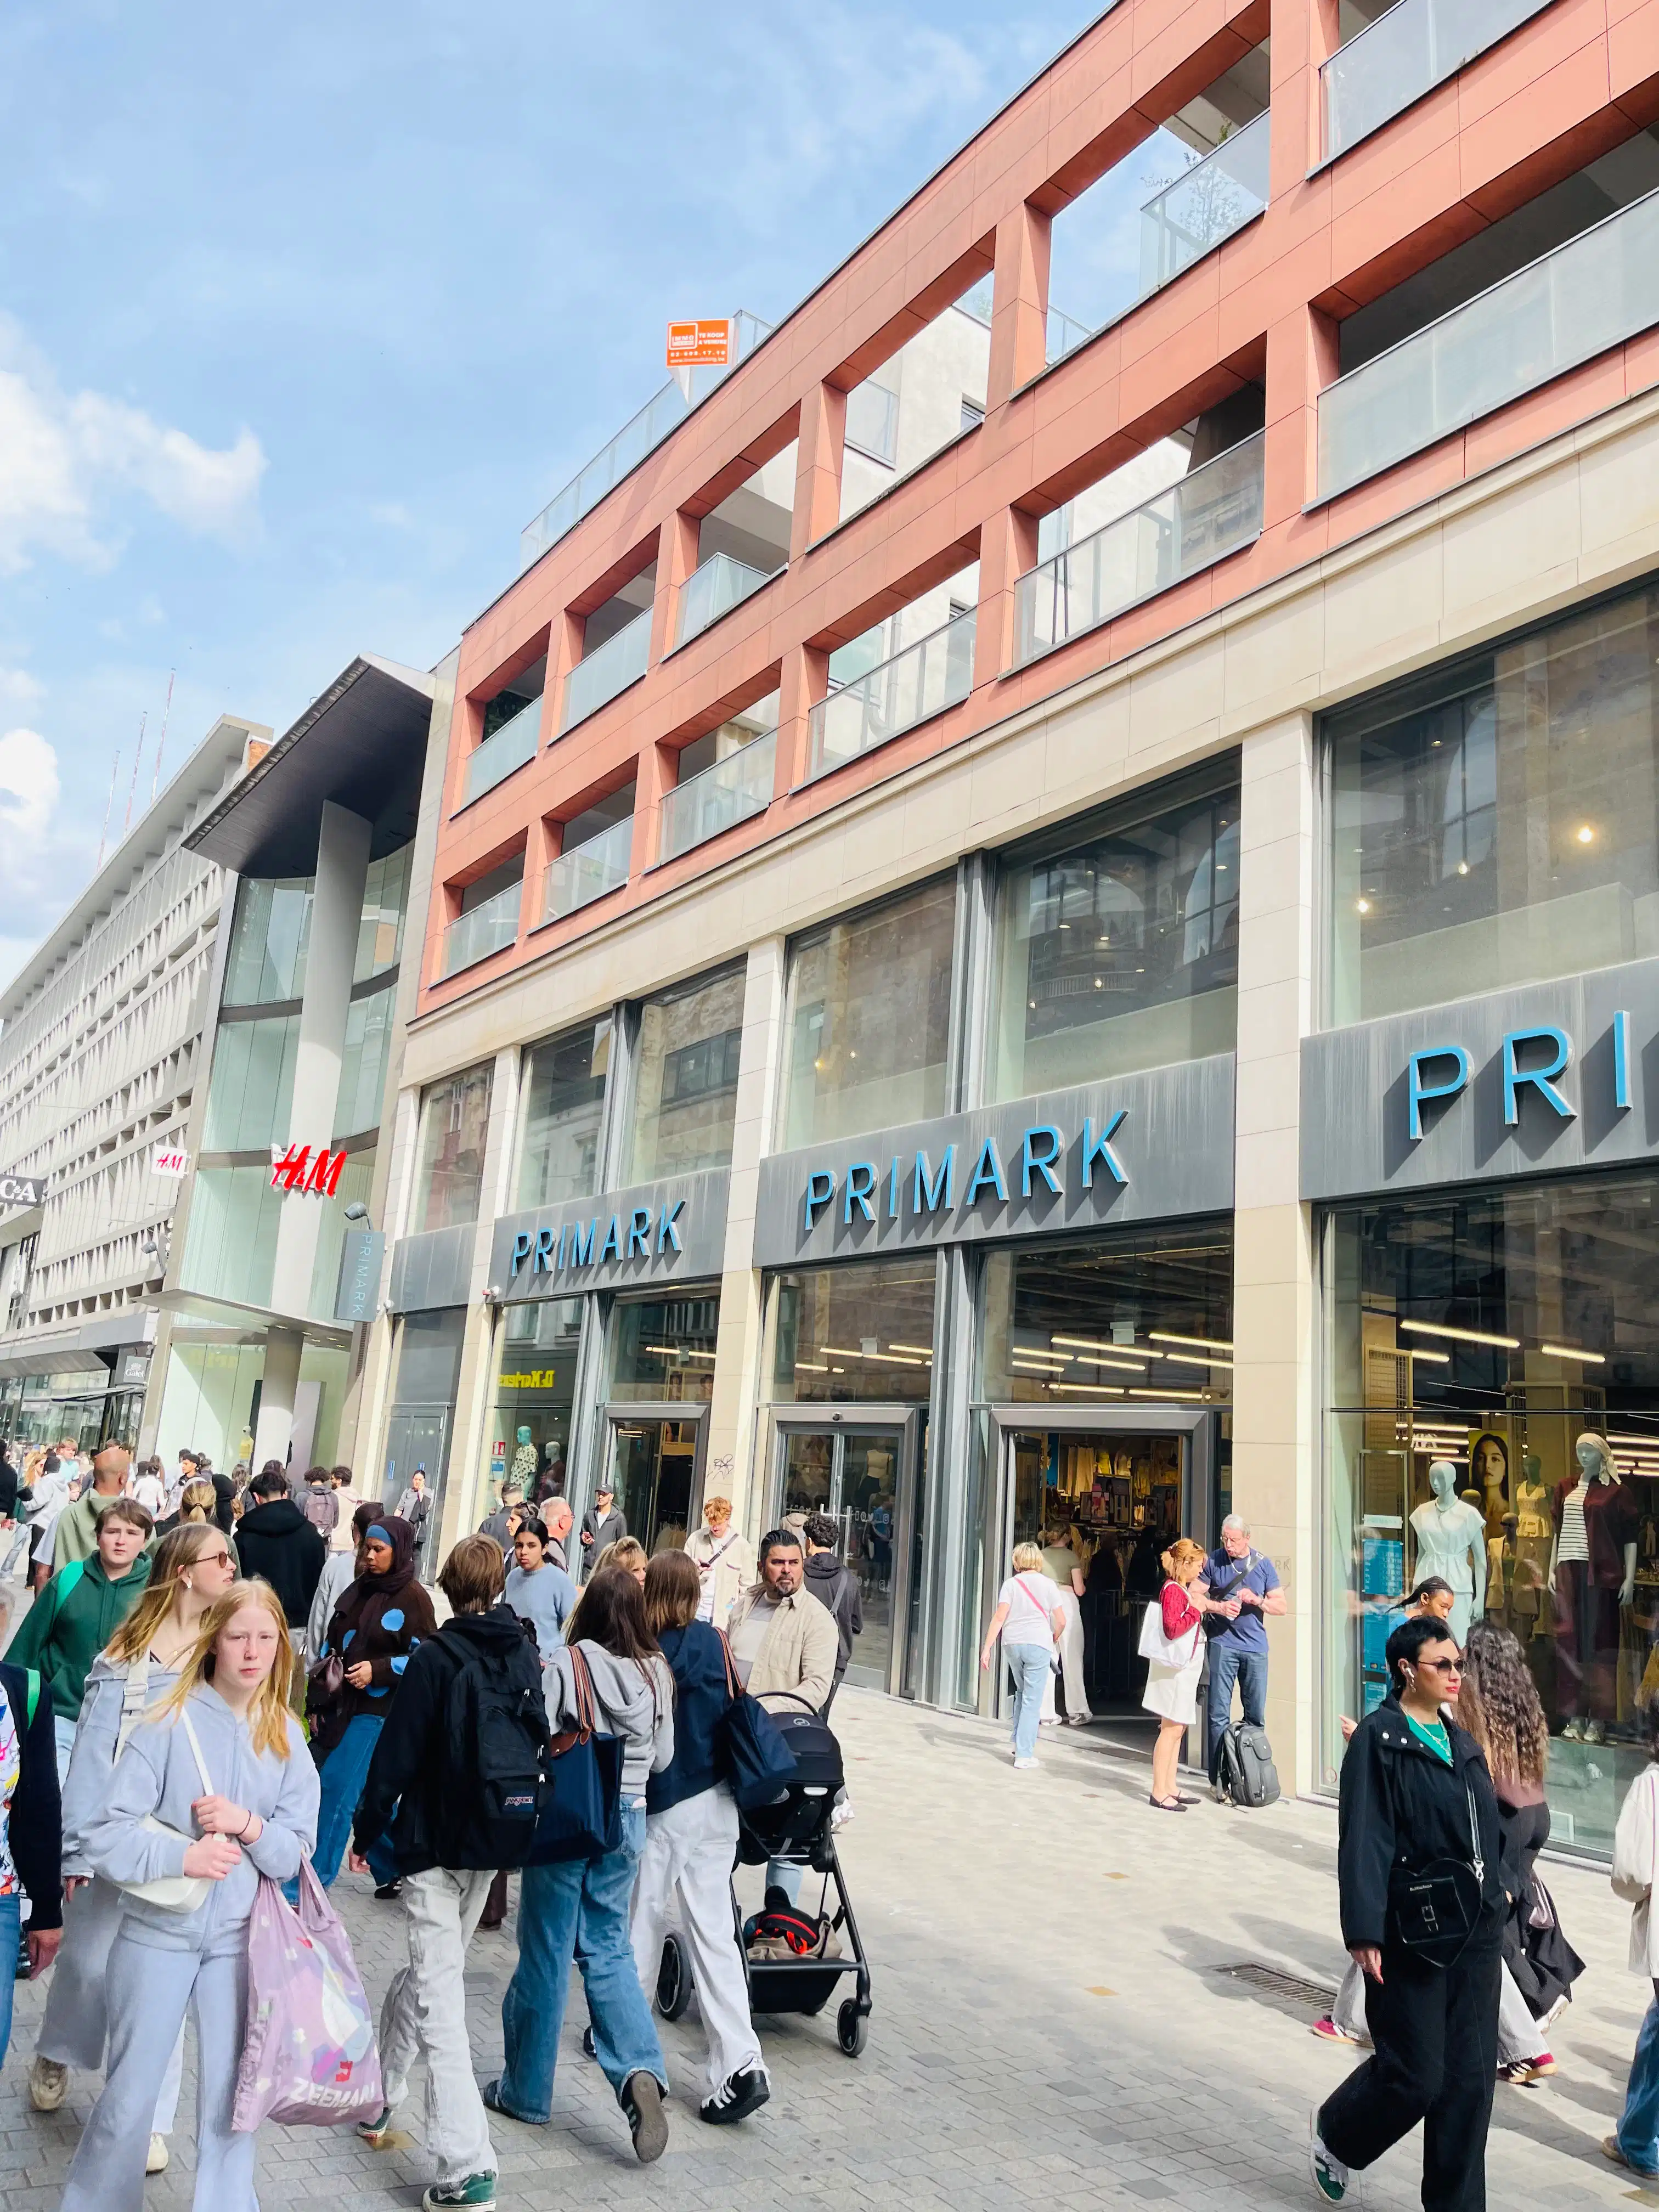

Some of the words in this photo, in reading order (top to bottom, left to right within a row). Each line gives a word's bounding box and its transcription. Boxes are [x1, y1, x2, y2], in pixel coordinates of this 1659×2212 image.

[156, 1153, 184, 1171] H&M
[270, 1143, 348, 1198] H&M
[804, 1110, 1130, 1231] PRIMARK
[0, 1179, 37, 1203] C&A
[511, 1199, 686, 1277] PRIMARK
[351, 1234, 373, 1314] PRIMARK
[290, 2076, 375, 2108] ZEEMAN
